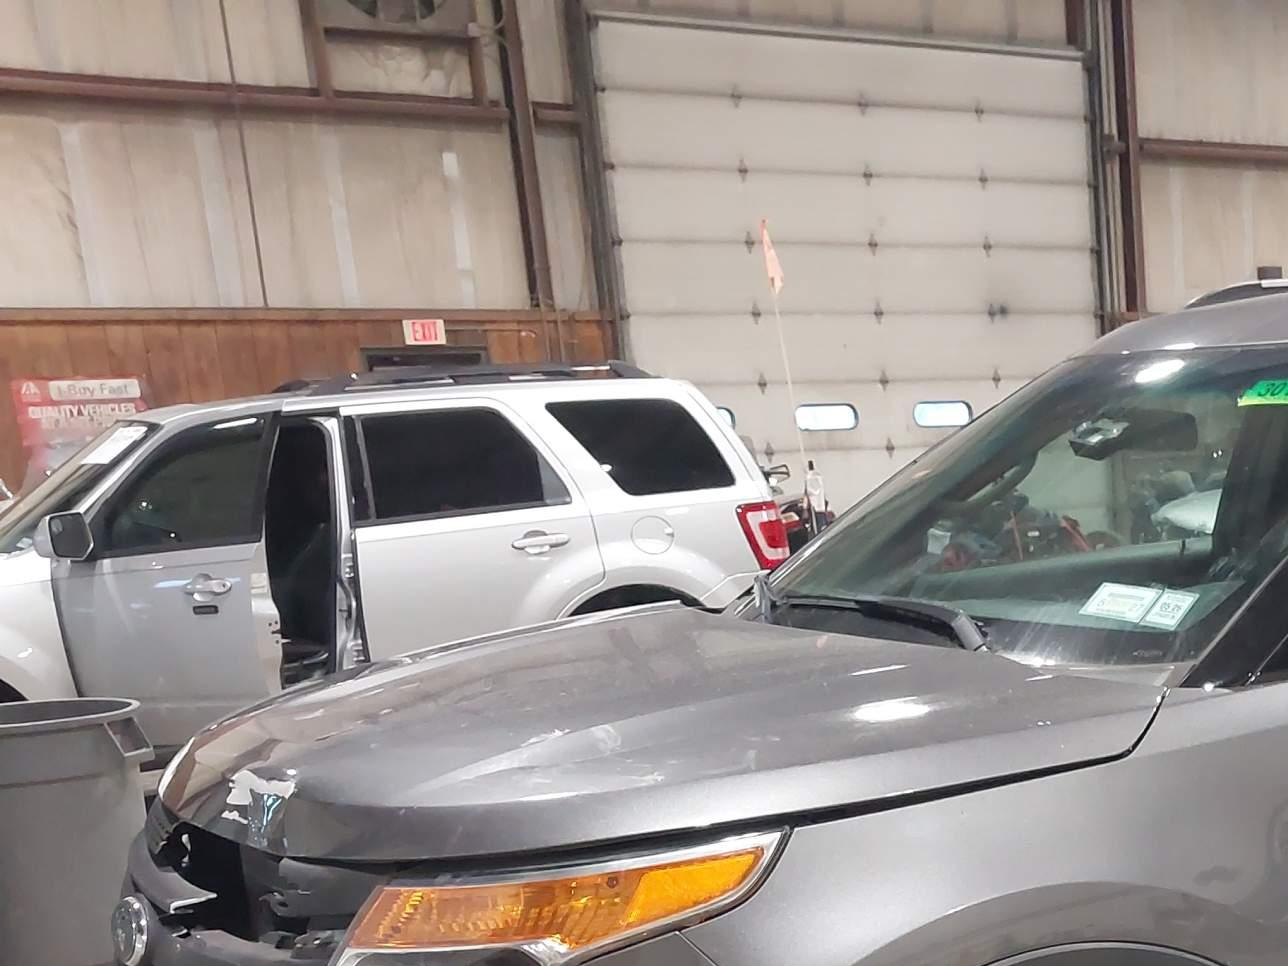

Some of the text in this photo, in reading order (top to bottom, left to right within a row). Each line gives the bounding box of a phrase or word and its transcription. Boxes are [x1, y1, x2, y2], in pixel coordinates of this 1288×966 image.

[411, 321, 438, 341] EXIT
[100, 382, 129, 394] Fast
[28, 402, 136, 418] QUALITY VEHICLES
